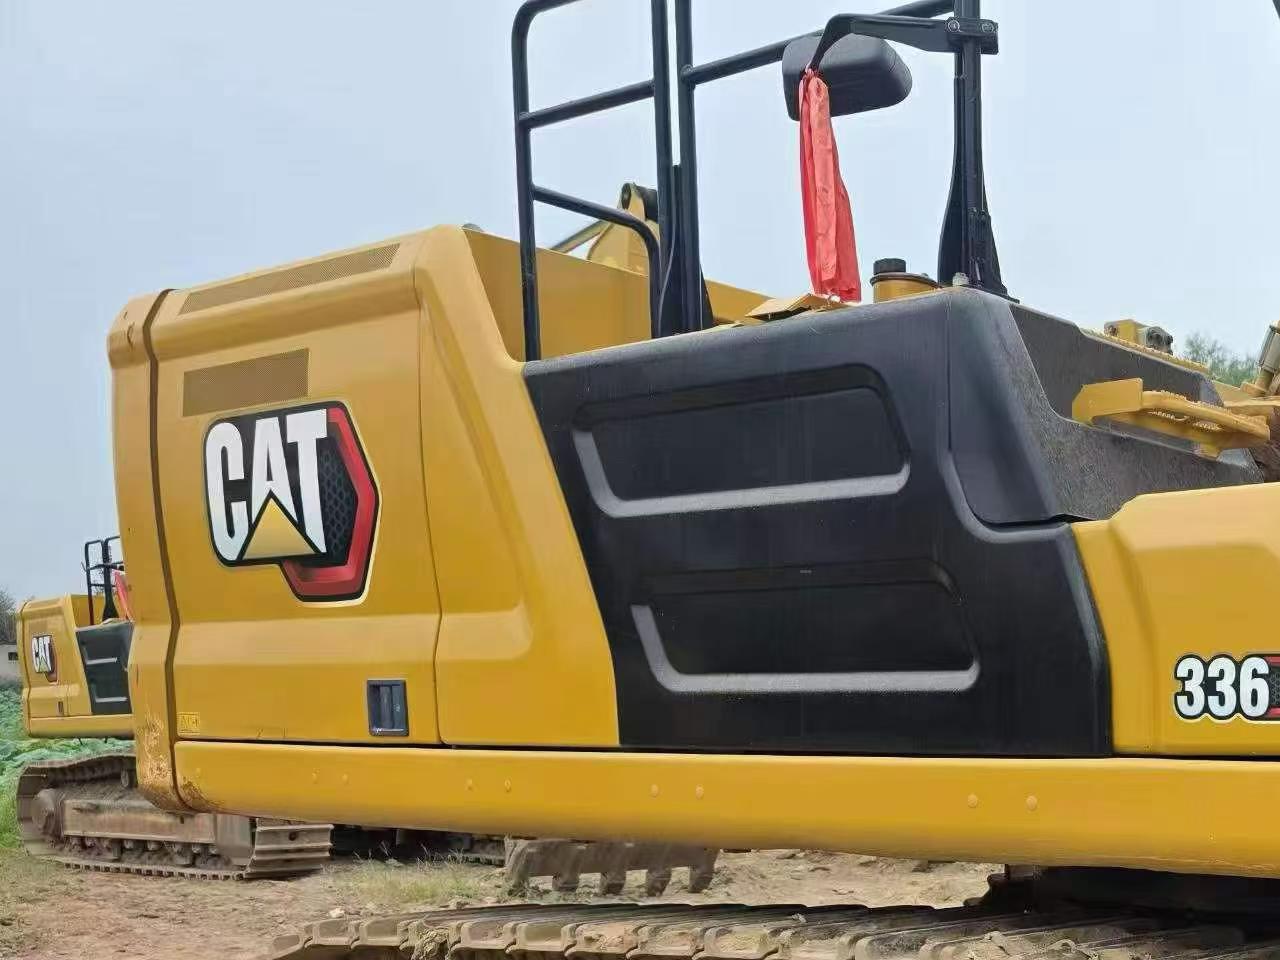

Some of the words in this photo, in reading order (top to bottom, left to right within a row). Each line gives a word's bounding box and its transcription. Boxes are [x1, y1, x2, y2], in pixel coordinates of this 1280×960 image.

[205, 408, 327, 561] CAT
[31, 635, 52, 673] CAT
[1176, 656, 1269, 717] 336
